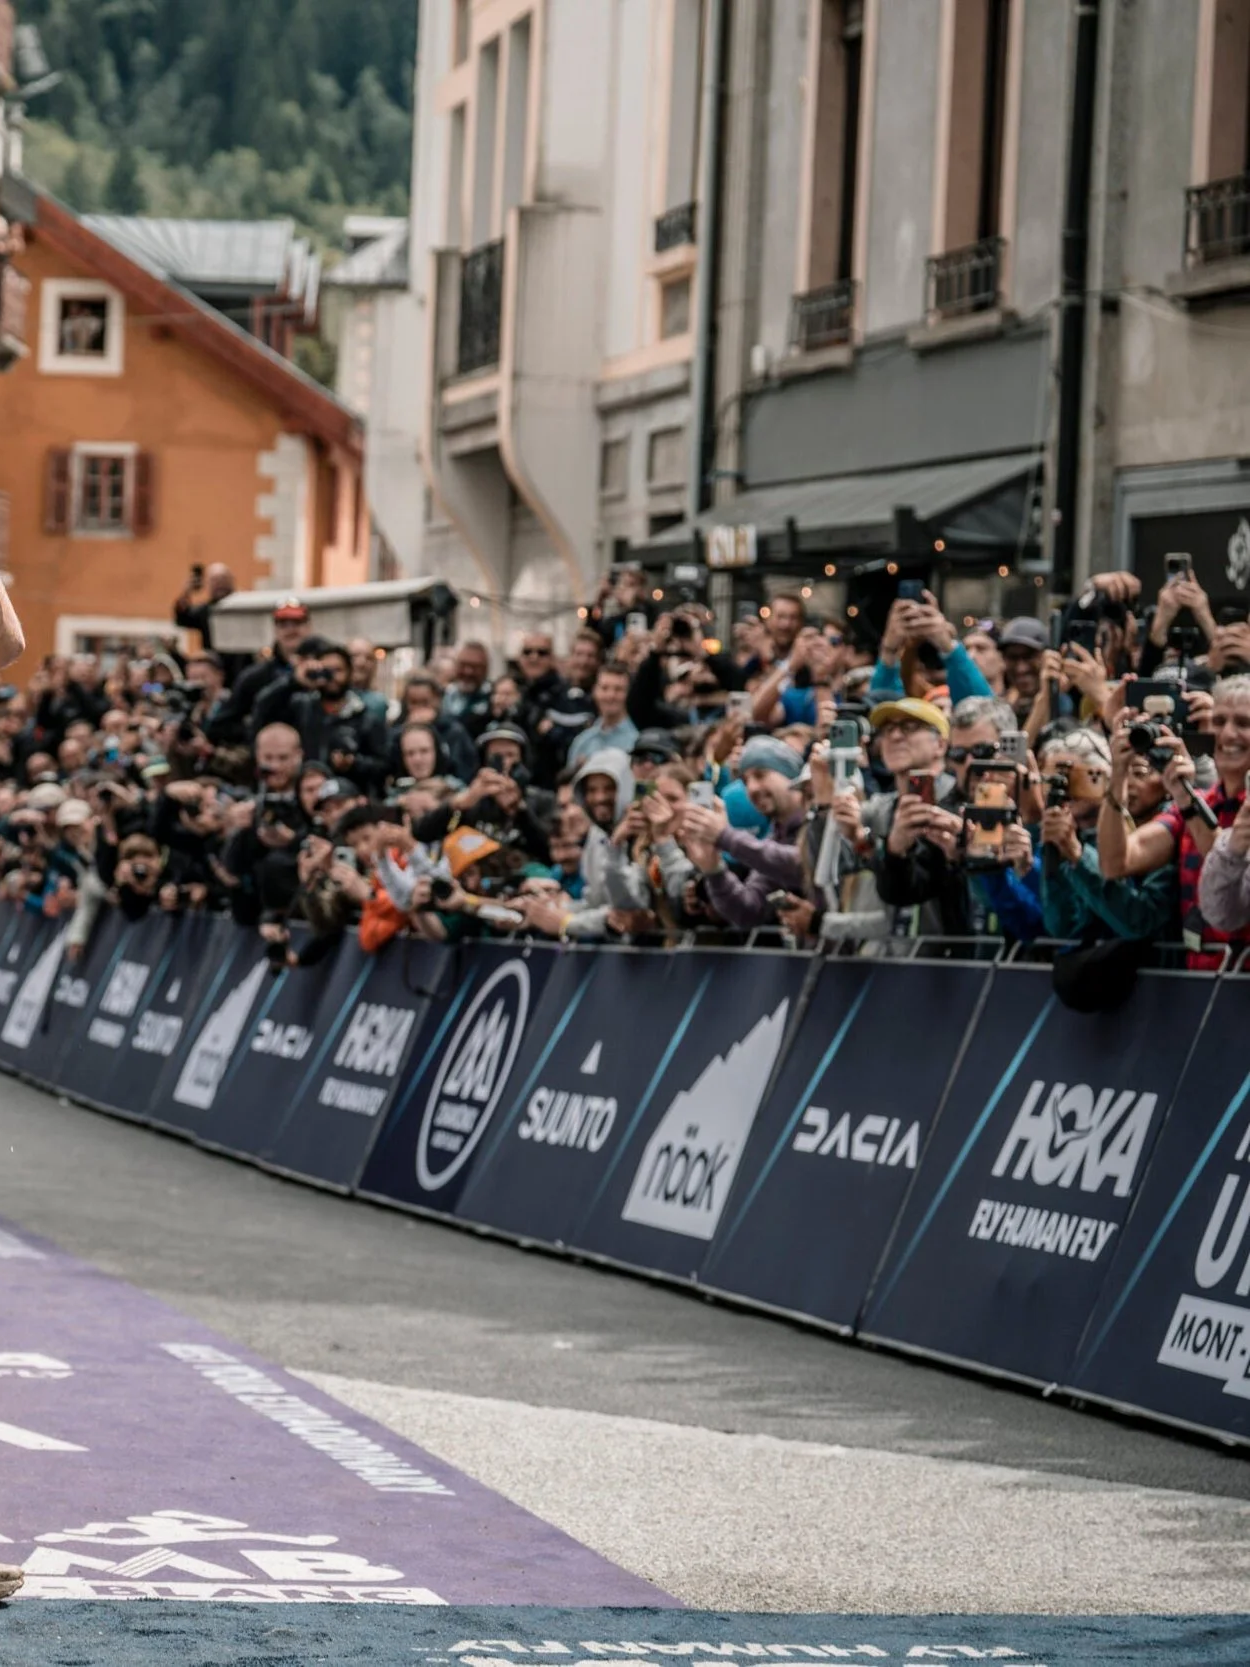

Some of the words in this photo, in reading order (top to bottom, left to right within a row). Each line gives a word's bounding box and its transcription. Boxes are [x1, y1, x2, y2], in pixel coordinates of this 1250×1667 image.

[518, 1085, 618, 1153] SUUNTO
[792, 1105, 920, 1169] DACIA
[991, 1080, 1158, 1197] HOKA
[967, 1198, 1008, 1241] FLY
[995, 1203, 1080, 1256] HUMAN
[1067, 1216, 1119, 1263] FLY
